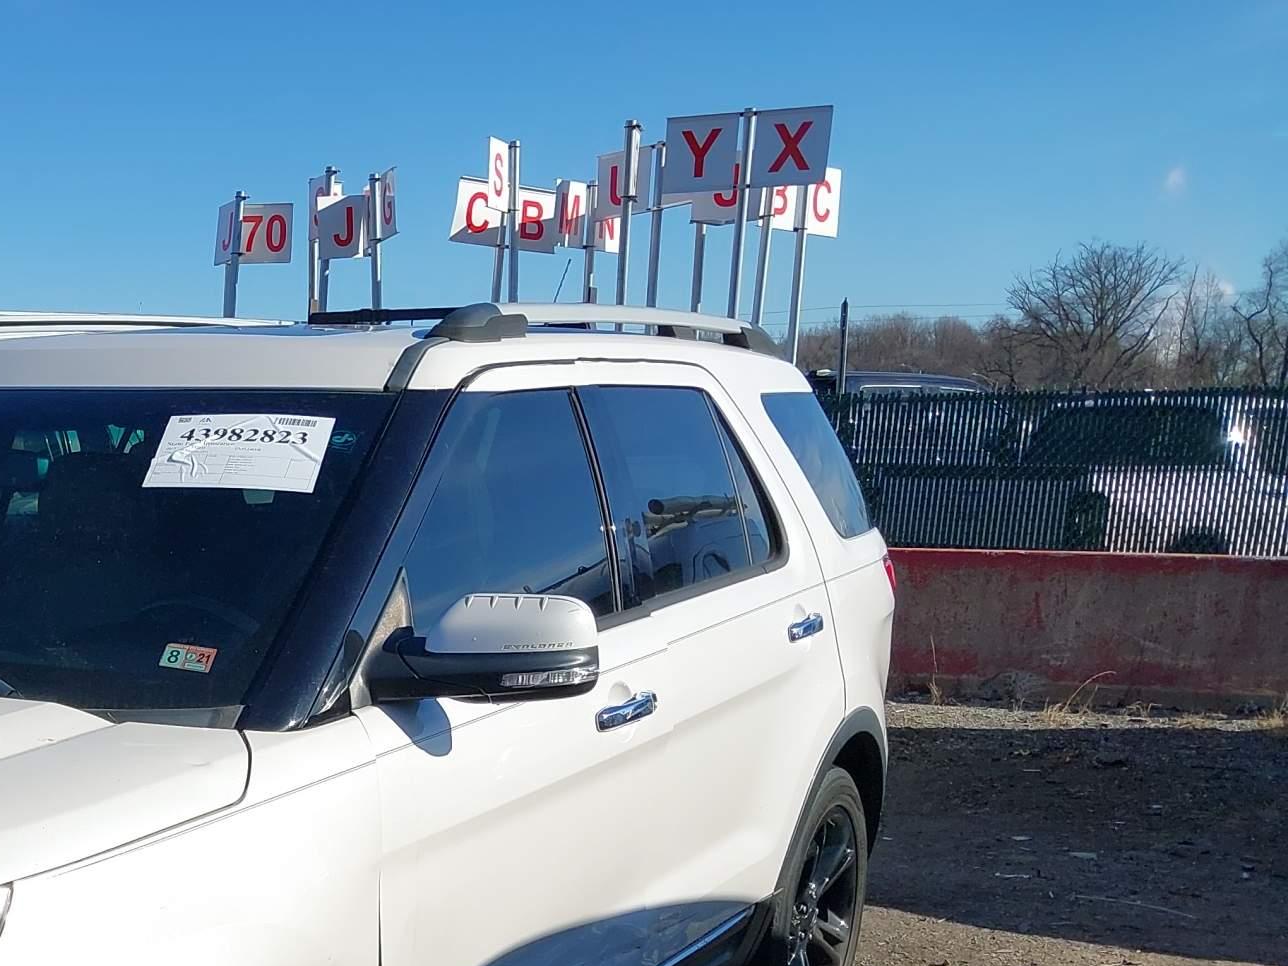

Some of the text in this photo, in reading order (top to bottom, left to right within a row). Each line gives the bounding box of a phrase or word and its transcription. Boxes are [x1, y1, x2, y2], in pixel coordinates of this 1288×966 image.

[682, 128, 723, 177] Y
[768, 121, 814, 172] X
[493, 153, 503, 197] S
[466, 192, 489, 233] C
[520, 200, 544, 240] B
[559, 192, 580, 235] M
[813, 179, 832, 222] C
[242, 214, 287, 252] 70
[333, 206, 353, 247] J
[179, 427, 308, 445] 43982823
[167, 650, 211, 664] 8 21
